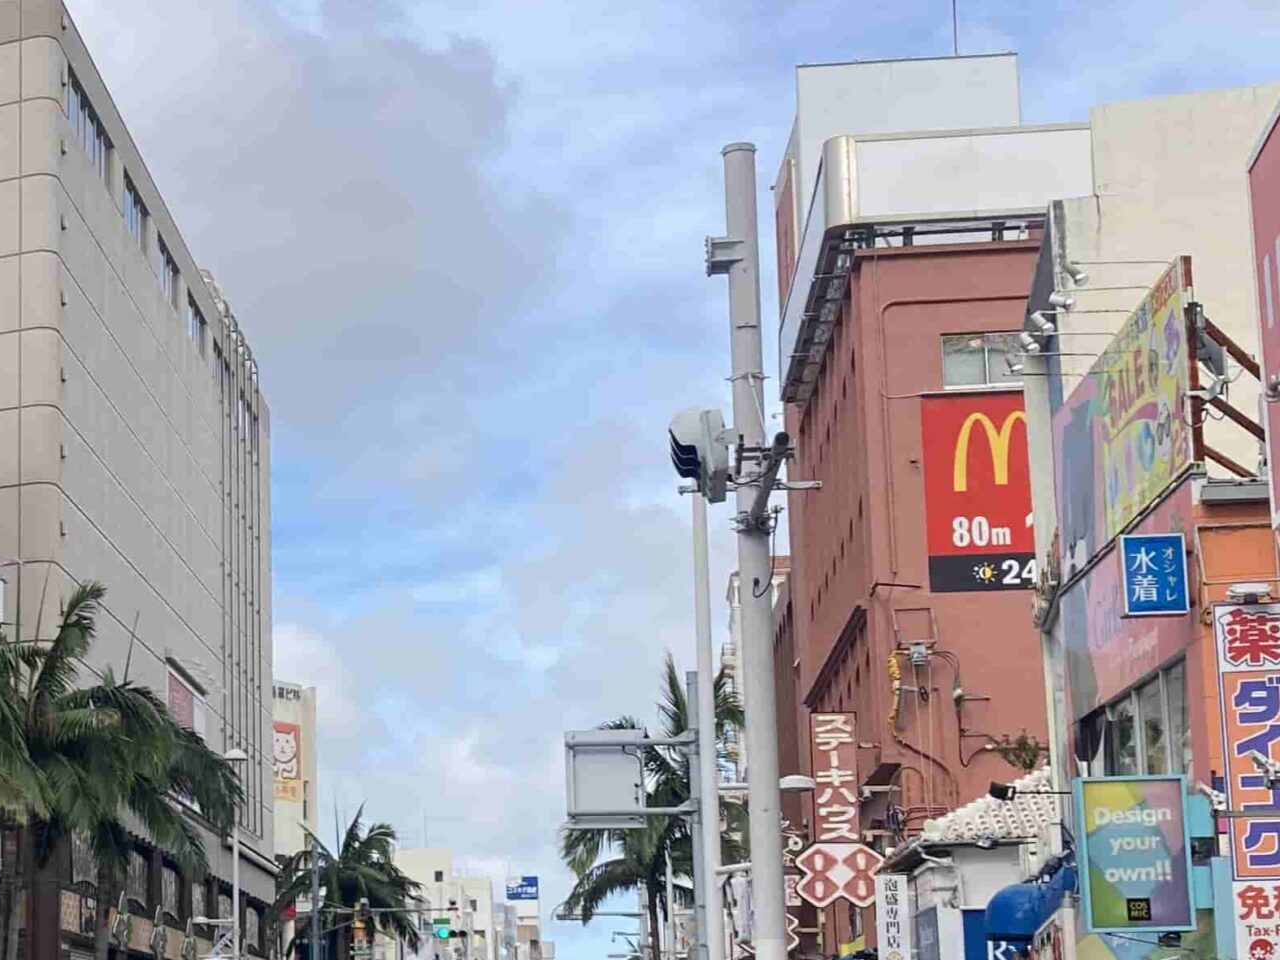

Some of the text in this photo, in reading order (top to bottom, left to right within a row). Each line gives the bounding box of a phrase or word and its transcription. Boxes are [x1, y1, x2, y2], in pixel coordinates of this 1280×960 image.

[952, 516, 1011, 547] 80m
[1130, 547, 1160, 602] 水着
[1163, 546, 1179, 601] オシャレ
[1226, 608, 1280, 665] 薬
[815, 715, 859, 841] ステーキハウス
[1094, 807, 1172, 827] Design
[1109, 836, 1160, 855] your
[1105, 862, 1172, 883] own!!
[1130, 901, 1148, 910] COS
[1131, 909, 1149, 918] MIC
